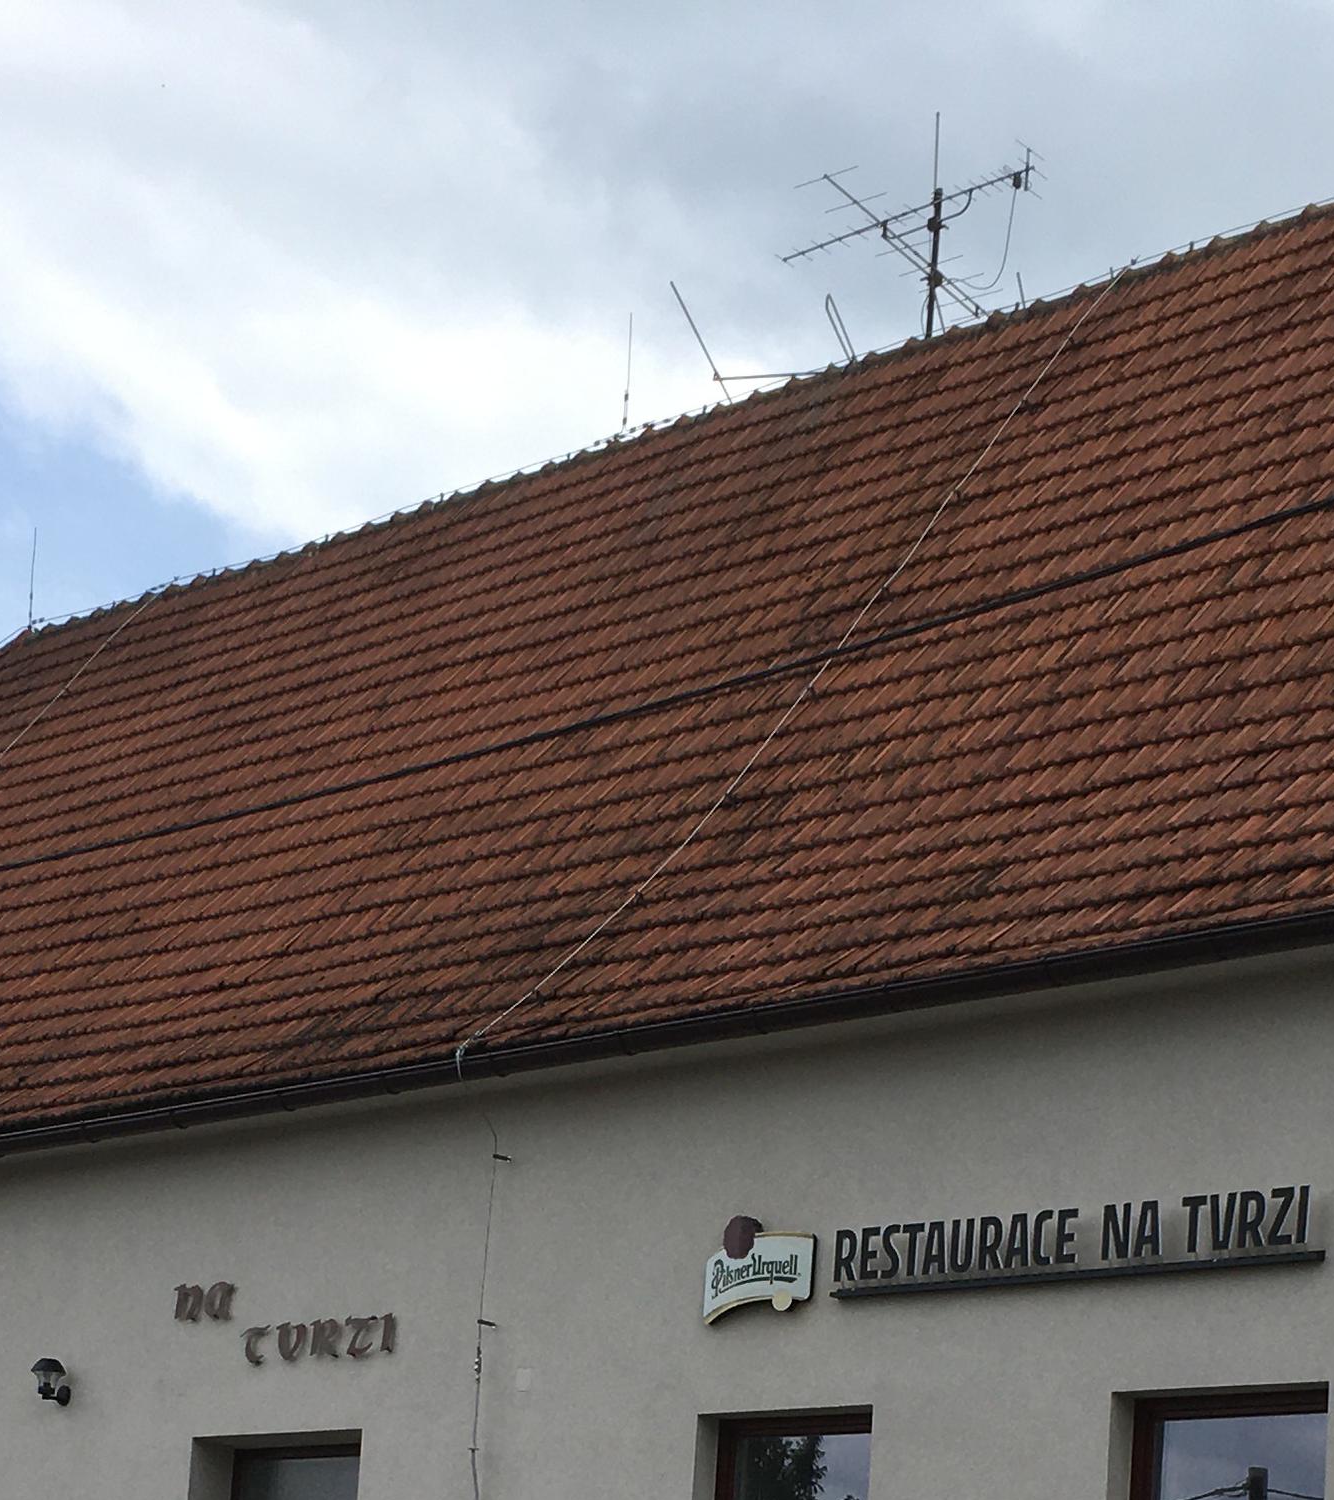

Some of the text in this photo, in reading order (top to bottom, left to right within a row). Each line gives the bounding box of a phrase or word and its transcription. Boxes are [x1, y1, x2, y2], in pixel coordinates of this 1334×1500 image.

[832, 1185, 1312, 1283] RESTAURACE NA TVRZI
[711, 1253, 799, 1300] Pilsner Urquell
